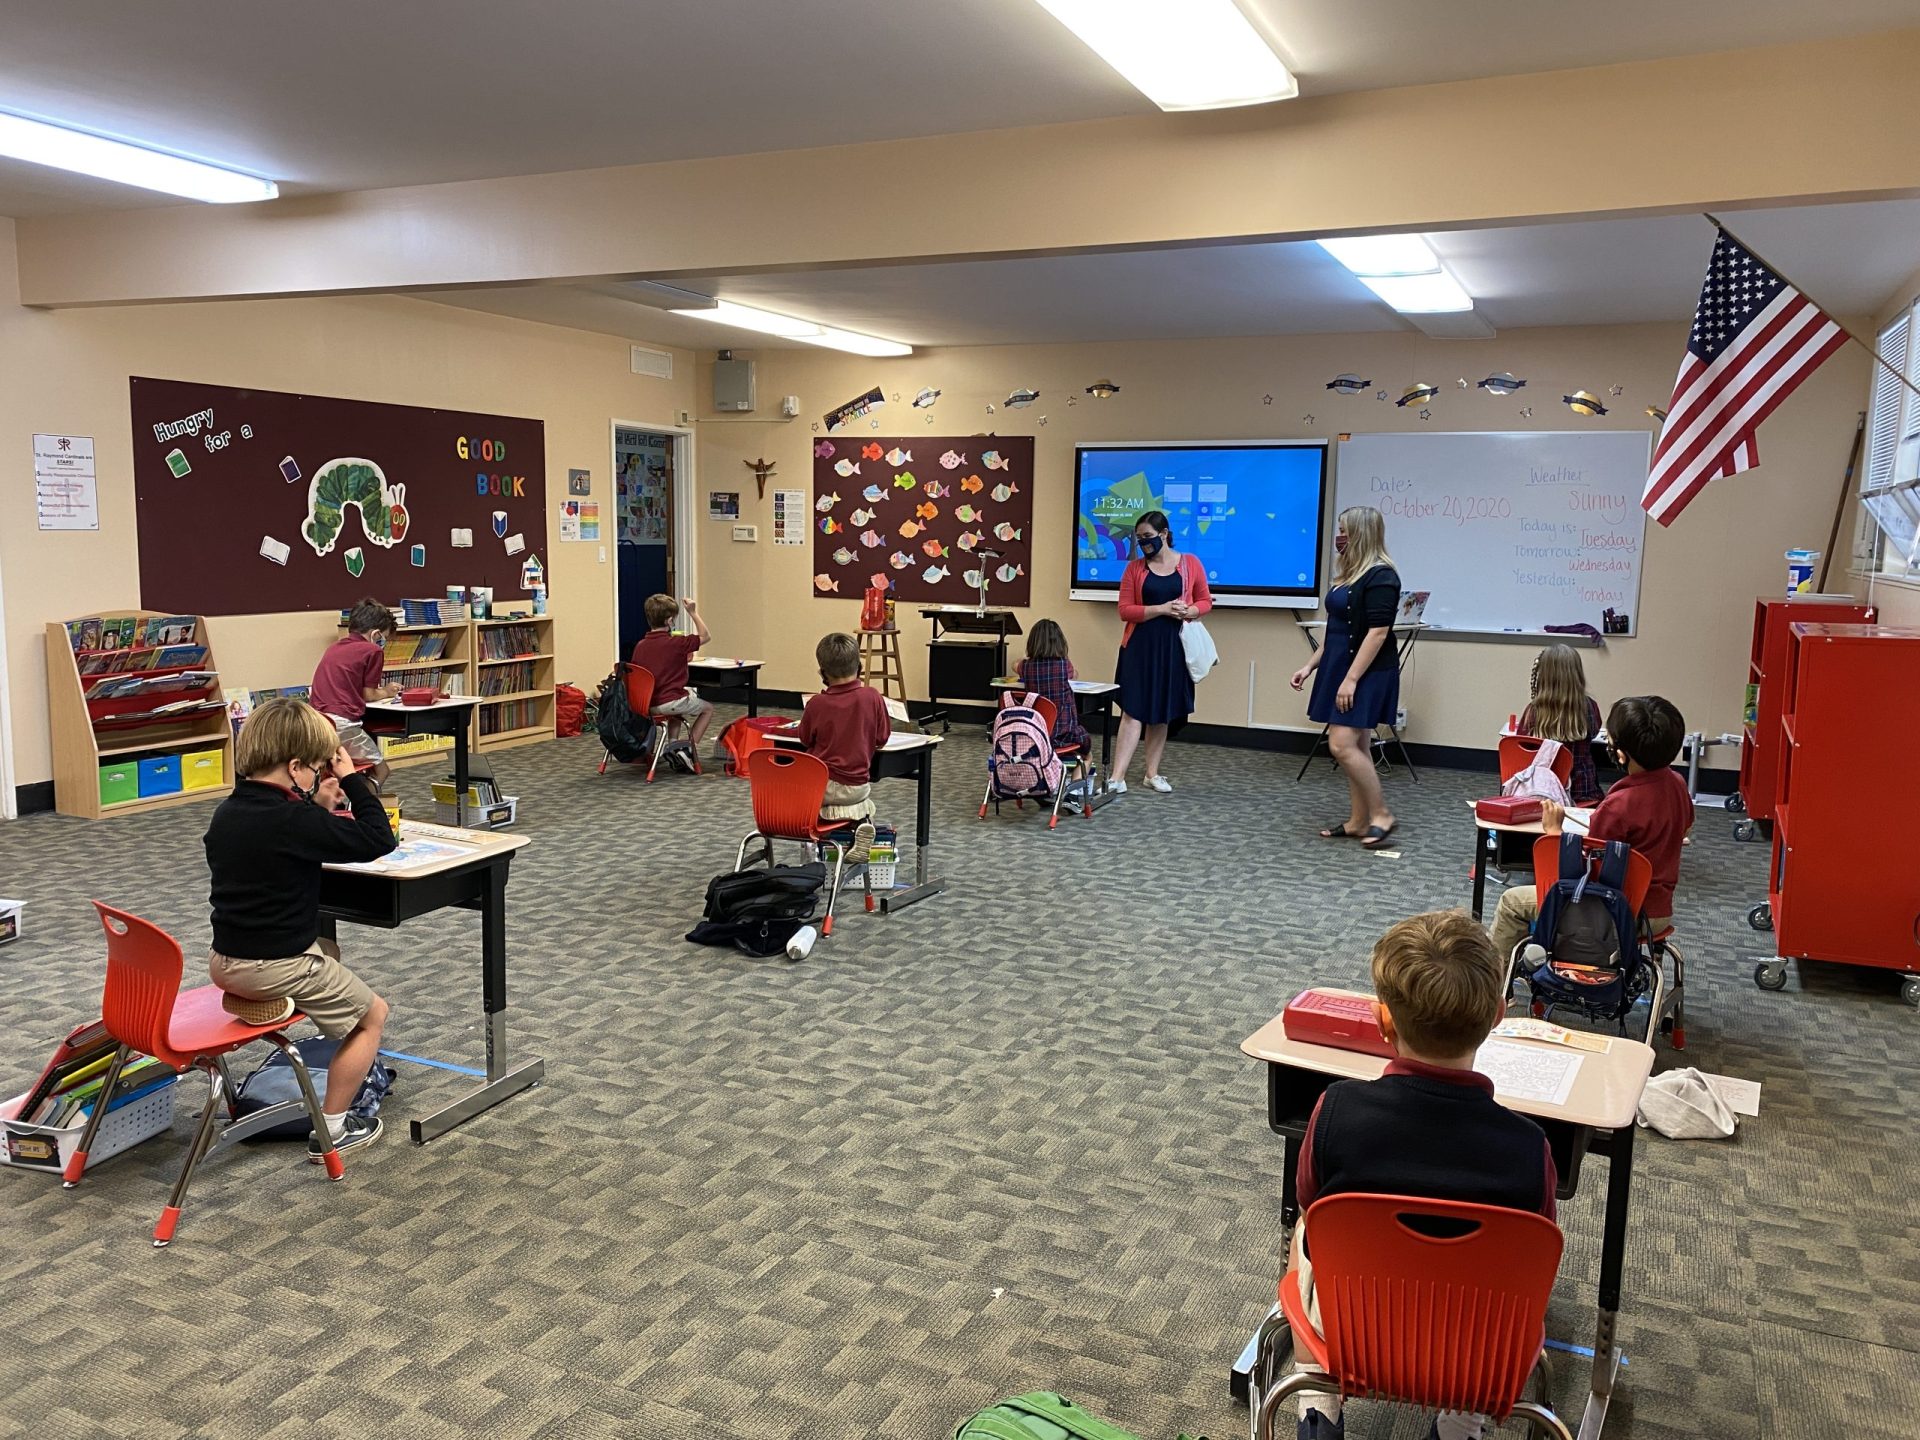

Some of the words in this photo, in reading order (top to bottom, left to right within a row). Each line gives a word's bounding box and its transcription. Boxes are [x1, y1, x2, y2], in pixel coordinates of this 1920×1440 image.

[153, 408, 214, 442] Hungry
[840, 403, 872, 427] SPARKLE
[204, 431, 231, 453] for
[241, 424, 253, 439] a
[457, 436, 505, 461] GOOD
[476, 473, 525, 497] BOOK
[1370, 476, 1412, 492] Date:
[1530, 465, 1588, 484] Weather
[1093, 498, 1123, 509] 11:32
[1126, 498, 1144, 509] AM
[1380, 495, 1439, 518] October
[1568, 490, 1627, 525] Sunny
[1518, 517, 1557, 541] Today
[1580, 528, 1638, 553] Tuesday
[1513, 544, 1581, 558] Tomorrow:
[1568, 556, 1632, 580] Wednesday
[1512, 568, 1576, 597] Yesterday:
